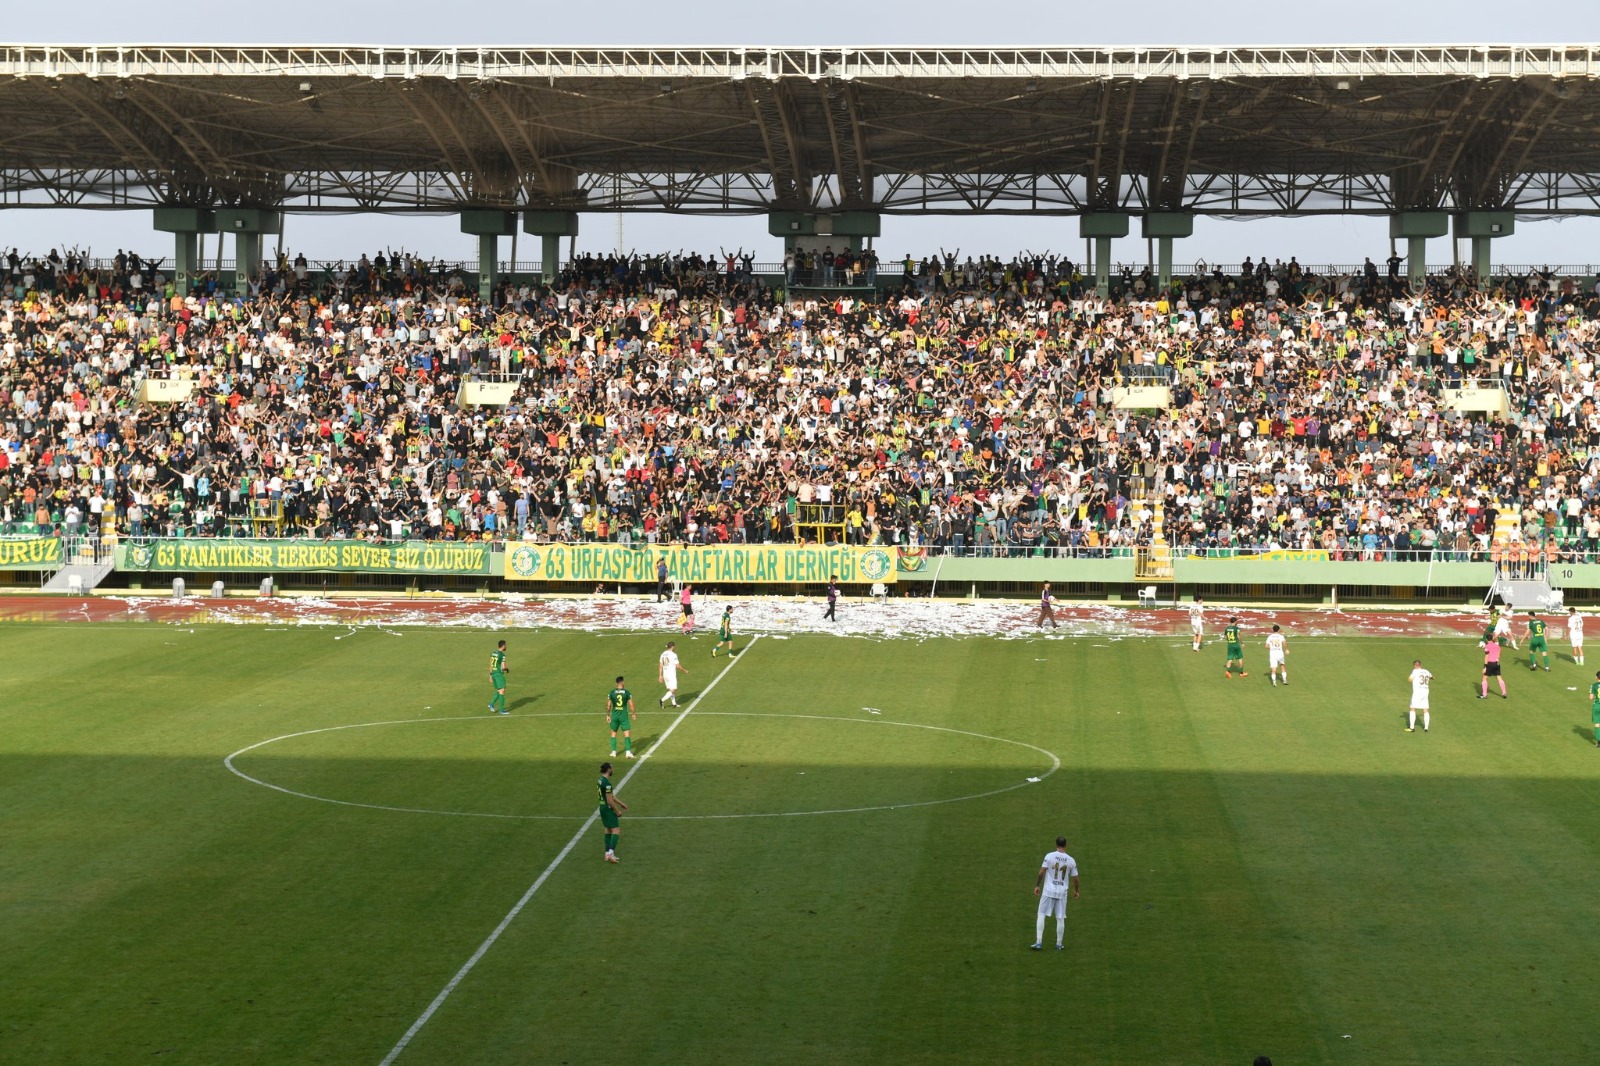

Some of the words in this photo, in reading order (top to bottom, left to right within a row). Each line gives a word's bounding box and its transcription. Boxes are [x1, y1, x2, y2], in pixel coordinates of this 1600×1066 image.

[157, 545, 175, 566] 63
[180, 540, 273, 567] FANATİKLER
[277, 546, 338, 567] HERKES
[342, 546, 391, 568] SEVER
[395, 543, 420, 569] BİZ
[424, 544, 483, 570] ÖLÜRÜZ
[546, 546, 564, 579] 63
[572, 548, 654, 580] URFASPOR
[1562, 569, 1573, 578] 10
[1536, 624, 1542, 633] 6
[1227, 631, 1235, 641] 14
[616, 695, 623, 706] 3
[1052, 862, 1067, 881] 11
